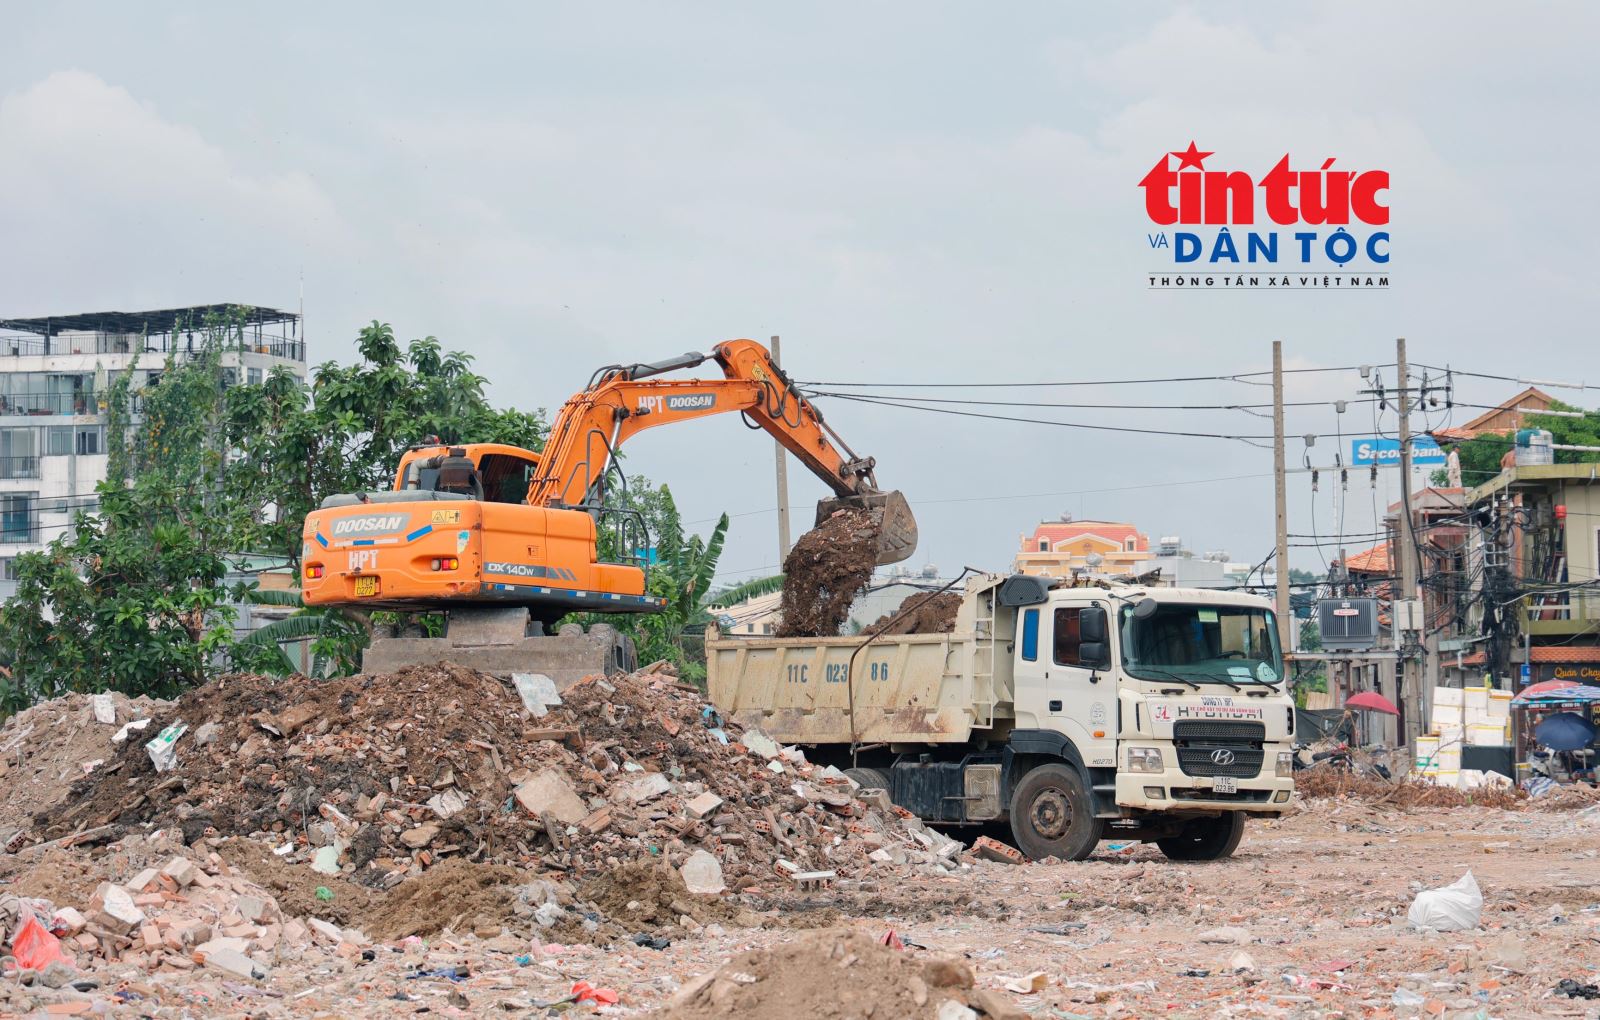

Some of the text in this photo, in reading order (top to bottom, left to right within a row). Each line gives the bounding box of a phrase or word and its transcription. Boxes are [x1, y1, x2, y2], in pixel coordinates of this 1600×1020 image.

[638, 395, 664, 413] HPT
[670, 396, 712, 408] DOOSAN
[1357, 443, 1446, 460] Sacobank
[335, 516, 402, 535] DOOSAN
[349, 550, 379, 569] HPT
[787, 662, 888, 683] 11C 023 86
[1220, 777, 1231, 785] 11C
